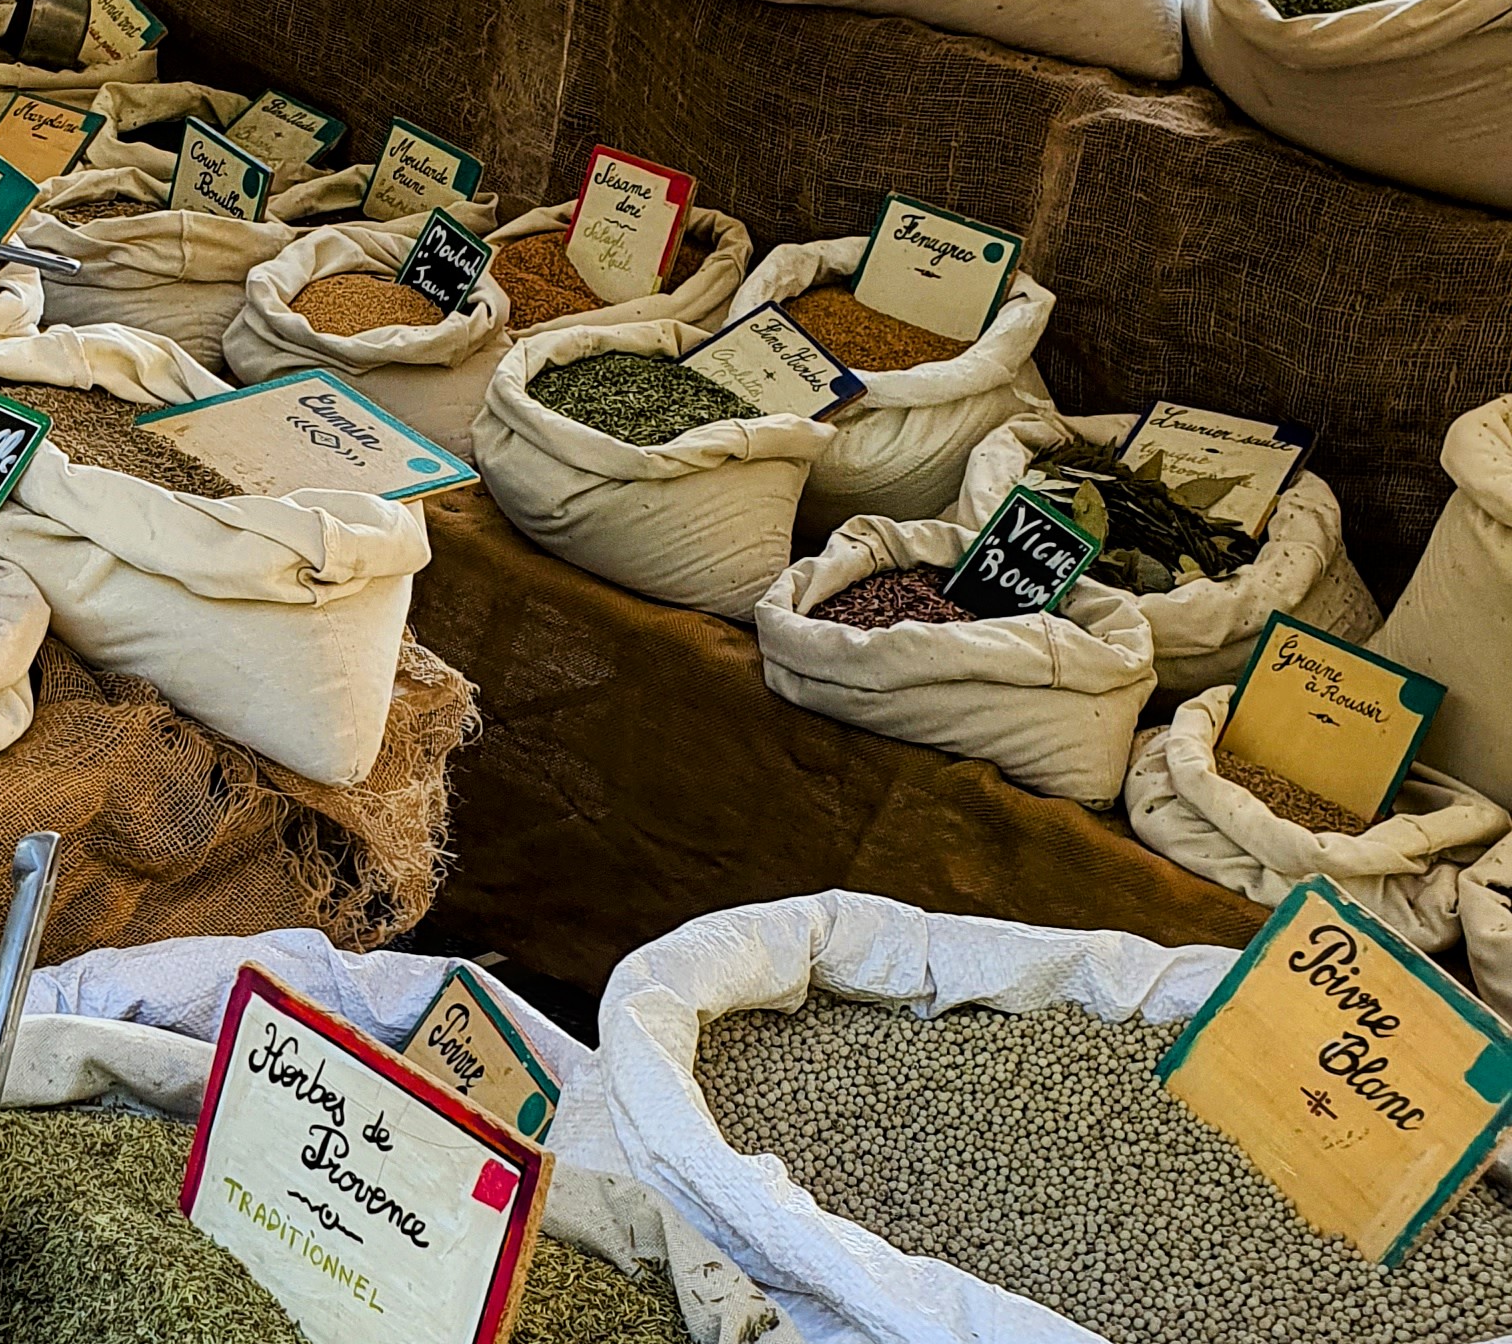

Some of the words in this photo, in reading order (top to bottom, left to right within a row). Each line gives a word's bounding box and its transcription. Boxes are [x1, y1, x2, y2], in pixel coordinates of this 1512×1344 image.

[389, 137, 449, 187] Moutarde
[392, 165, 426, 197] brune
[594, 161, 653, 200] Sésame
[193, 170, 249, 222] Bouillon
[893, 213, 978, 267] Fenugrec
[749, 318, 797, 354] Fines
[779, 346, 829, 393] Herbes
[298, 393, 383, 452] Cumin
[1271, 633, 1345, 683] Graine
[1304, 675, 1319, 693] à
[1319, 684, 1390, 724] Roussir
[1288, 924, 1401, 1039] Poivre
[427, 1002, 487, 1089] Poivre
[248, 1022, 346, 1128] Herbes
[361, 1110, 394, 1152] de
[1318, 1031, 1426, 1132] Blanc
[300, 1124, 430, 1249] Provence
